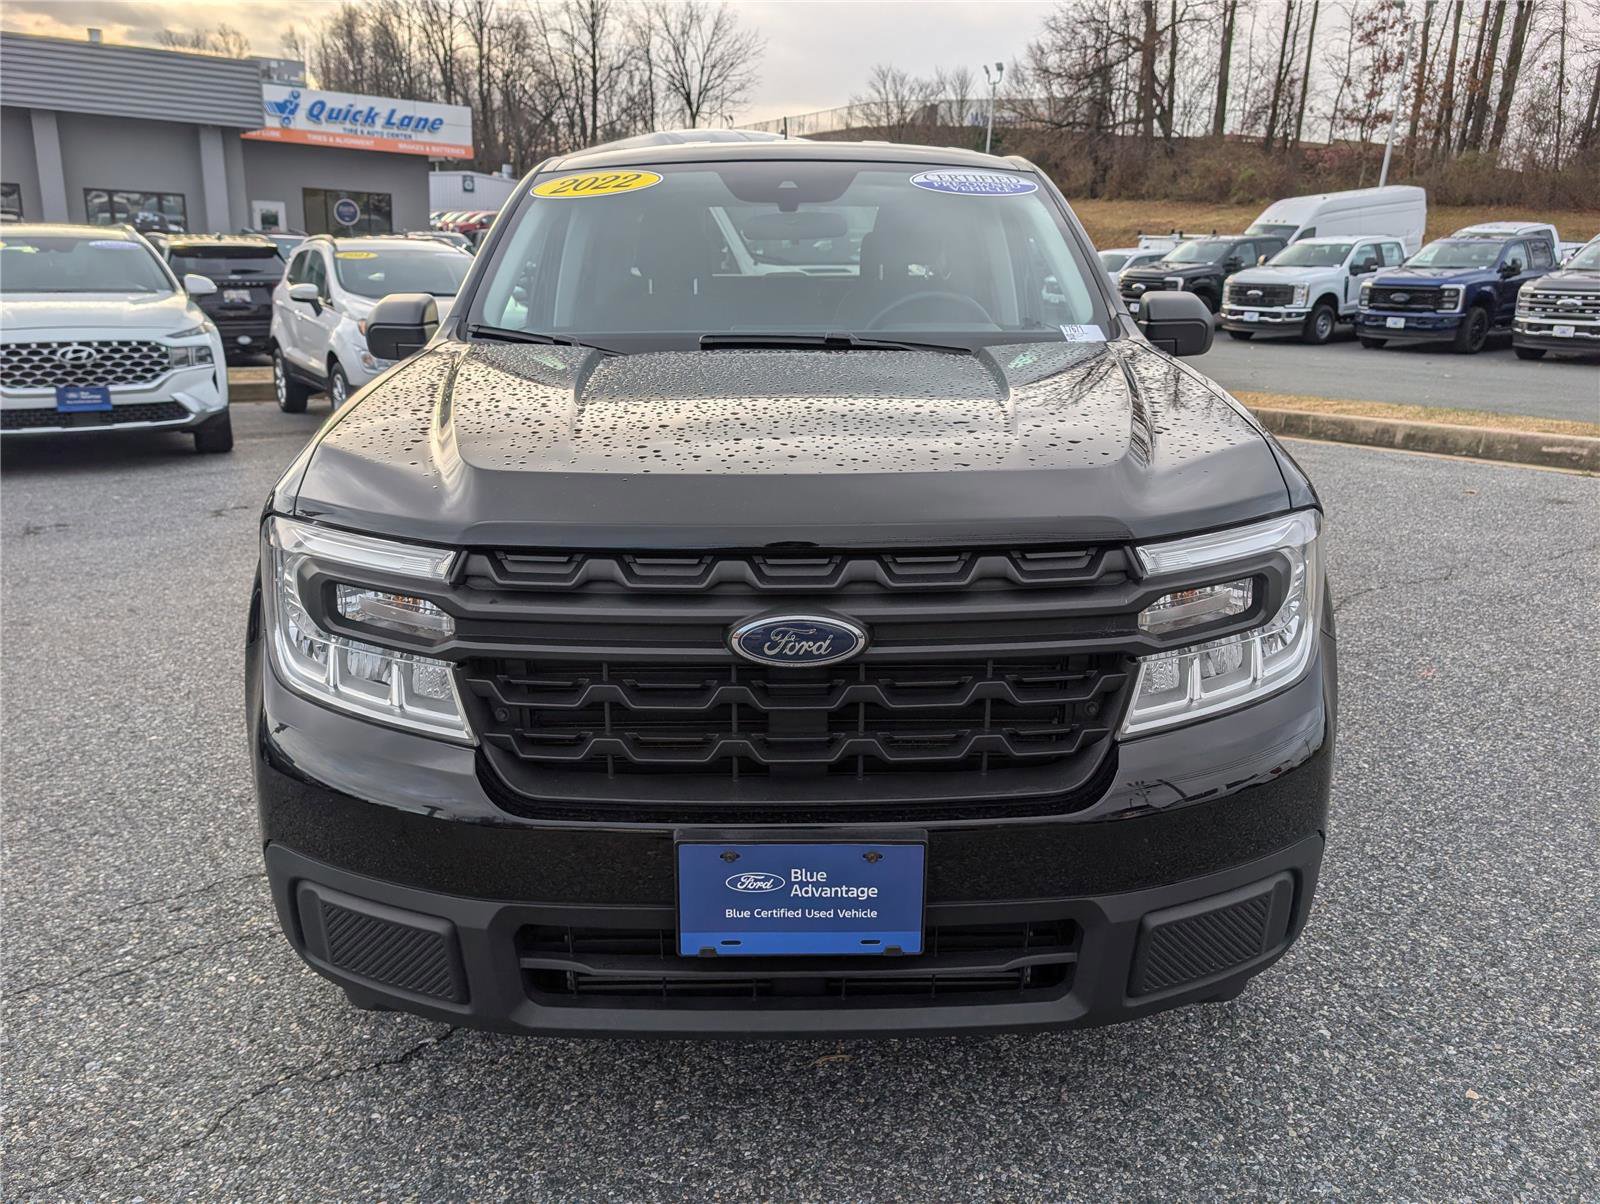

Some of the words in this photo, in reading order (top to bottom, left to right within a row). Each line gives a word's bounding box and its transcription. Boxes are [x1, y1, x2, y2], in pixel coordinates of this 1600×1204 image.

[306, 99, 380, 127] Quick
[382, 108, 445, 133] Lane
[386, 131, 413, 140] CENTER
[549, 173, 642, 195] 2022
[924, 173, 1021, 184] CERTIFIED
[950, 185, 1013, 193] VEHICLE
[764, 627, 834, 655] Ford
[790, 868, 827, 882] Blue
[790, 884, 878, 900] Advantage
[725, 908, 750, 918] Blue
[754, 908, 802, 918] Certified
[805, 908, 834, 918] Used
[837, 908, 878, 918] Vehicle
